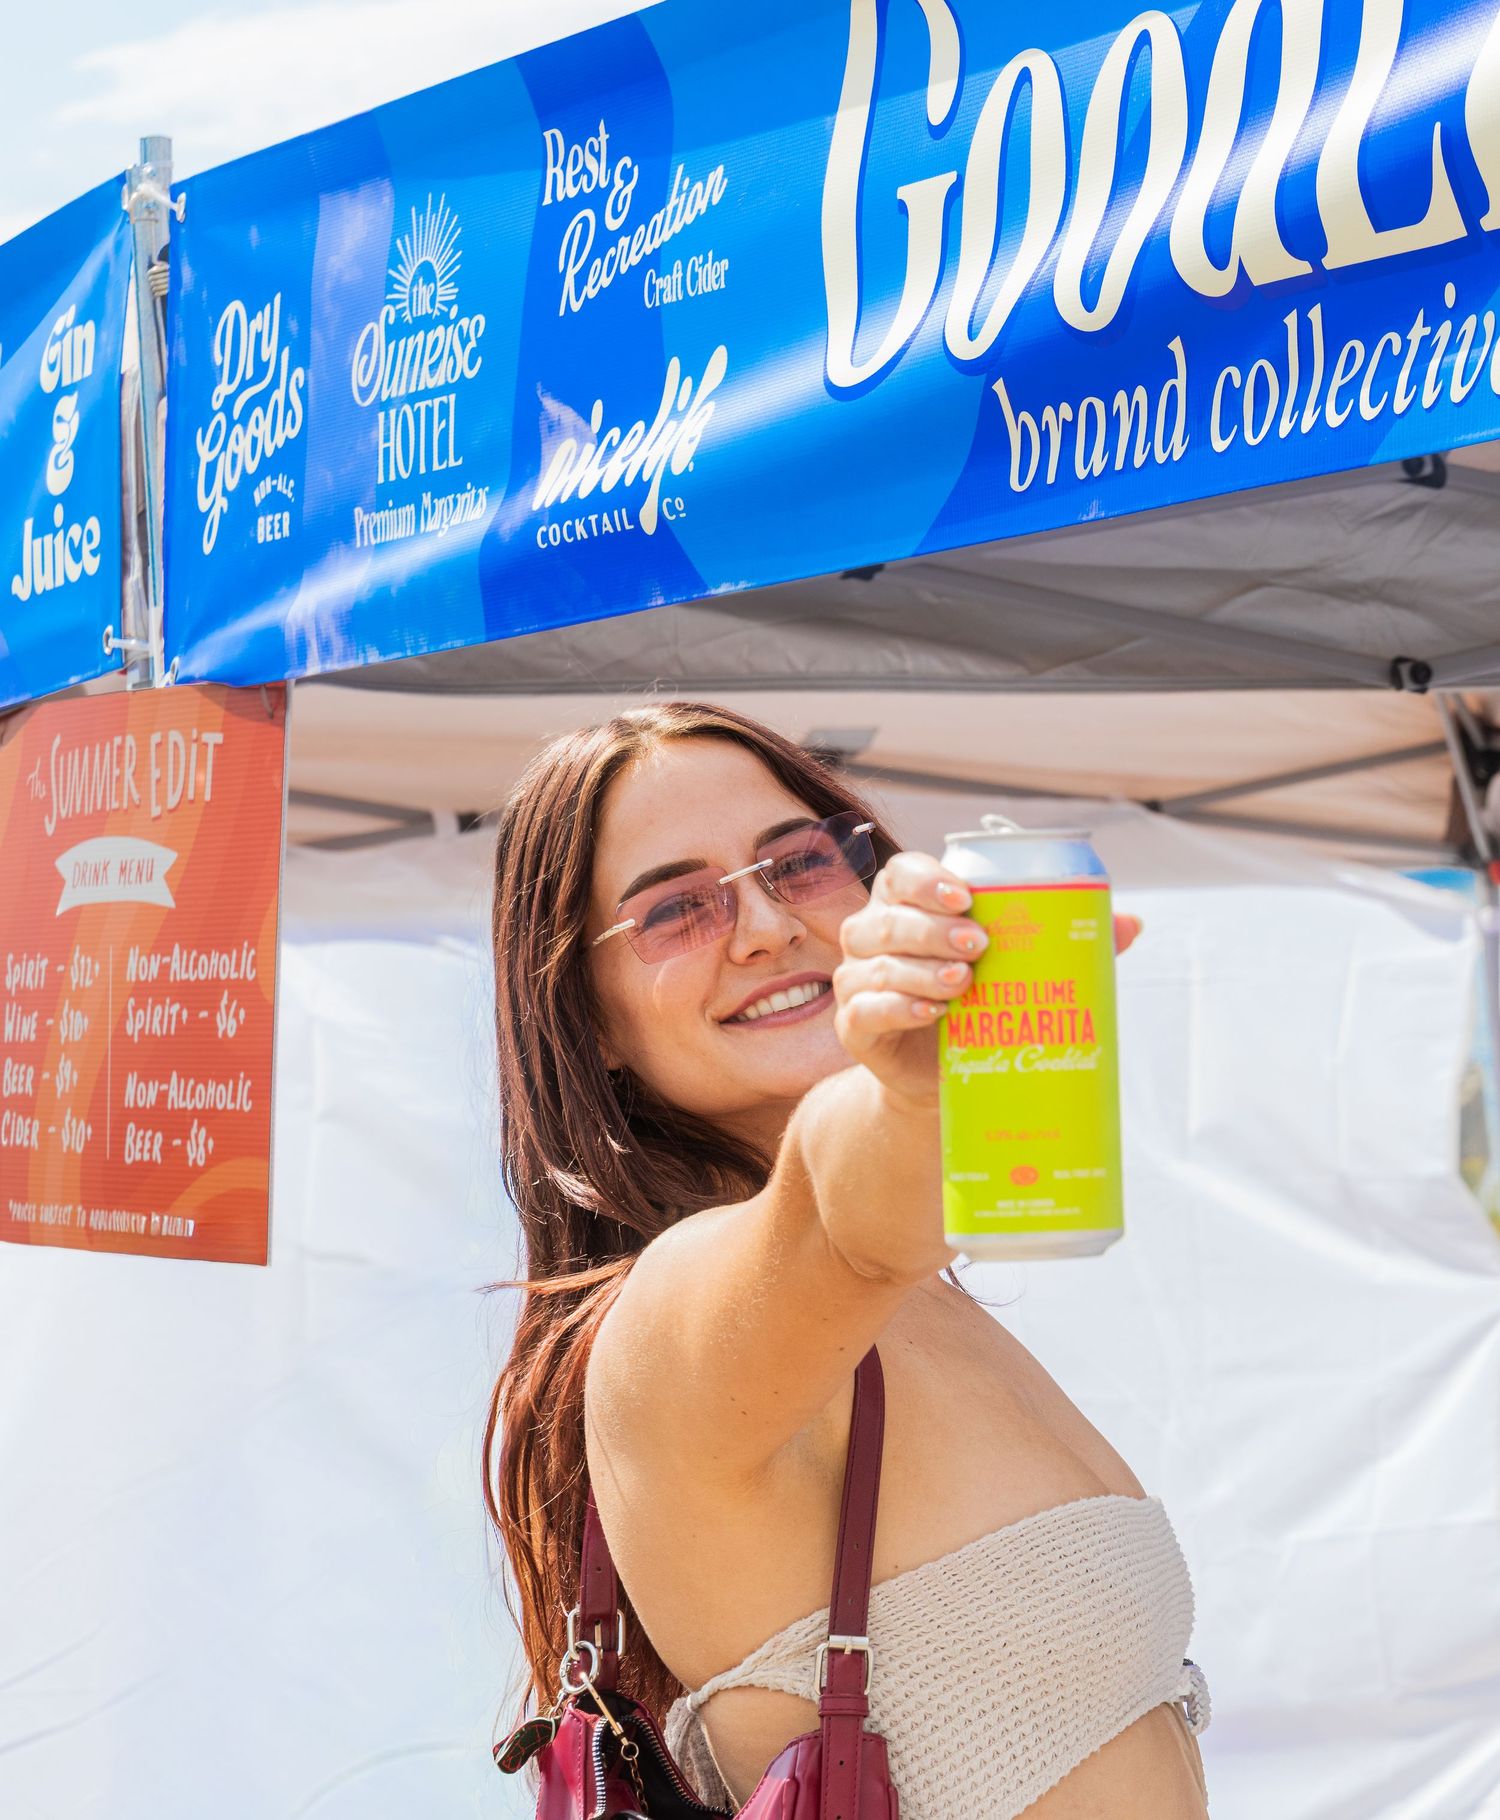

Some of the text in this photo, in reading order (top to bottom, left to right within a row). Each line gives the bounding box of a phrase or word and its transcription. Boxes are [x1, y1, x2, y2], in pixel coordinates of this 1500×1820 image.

[542, 118, 611, 206] Rest
[605, 156, 639, 231] &
[558, 163, 728, 317] Recreation
[644, 250, 729, 309] Craft Cider
[411, 274, 436, 318] the
[40, 304, 95, 394] Gin
[212, 291, 281, 420] Dry
[991, 281, 1500, 494] brand collectiv
[46, 391, 80, 496] &
[196, 346, 304, 555] Goods
[377, 391, 463, 485] HOTEL
[11, 502, 101, 602] Juice
[257, 511, 290, 544] BEER
[354, 482, 490, 548] Premium Margaritas
[536, 508, 634, 549] COCKTAIL
[44, 733, 140, 837] SUMMER
[71, 857, 155, 888] DRINK MENU
[948, 1008, 1096, 1048] MARGARITA
[1033, 979, 1077, 1006] LIME
